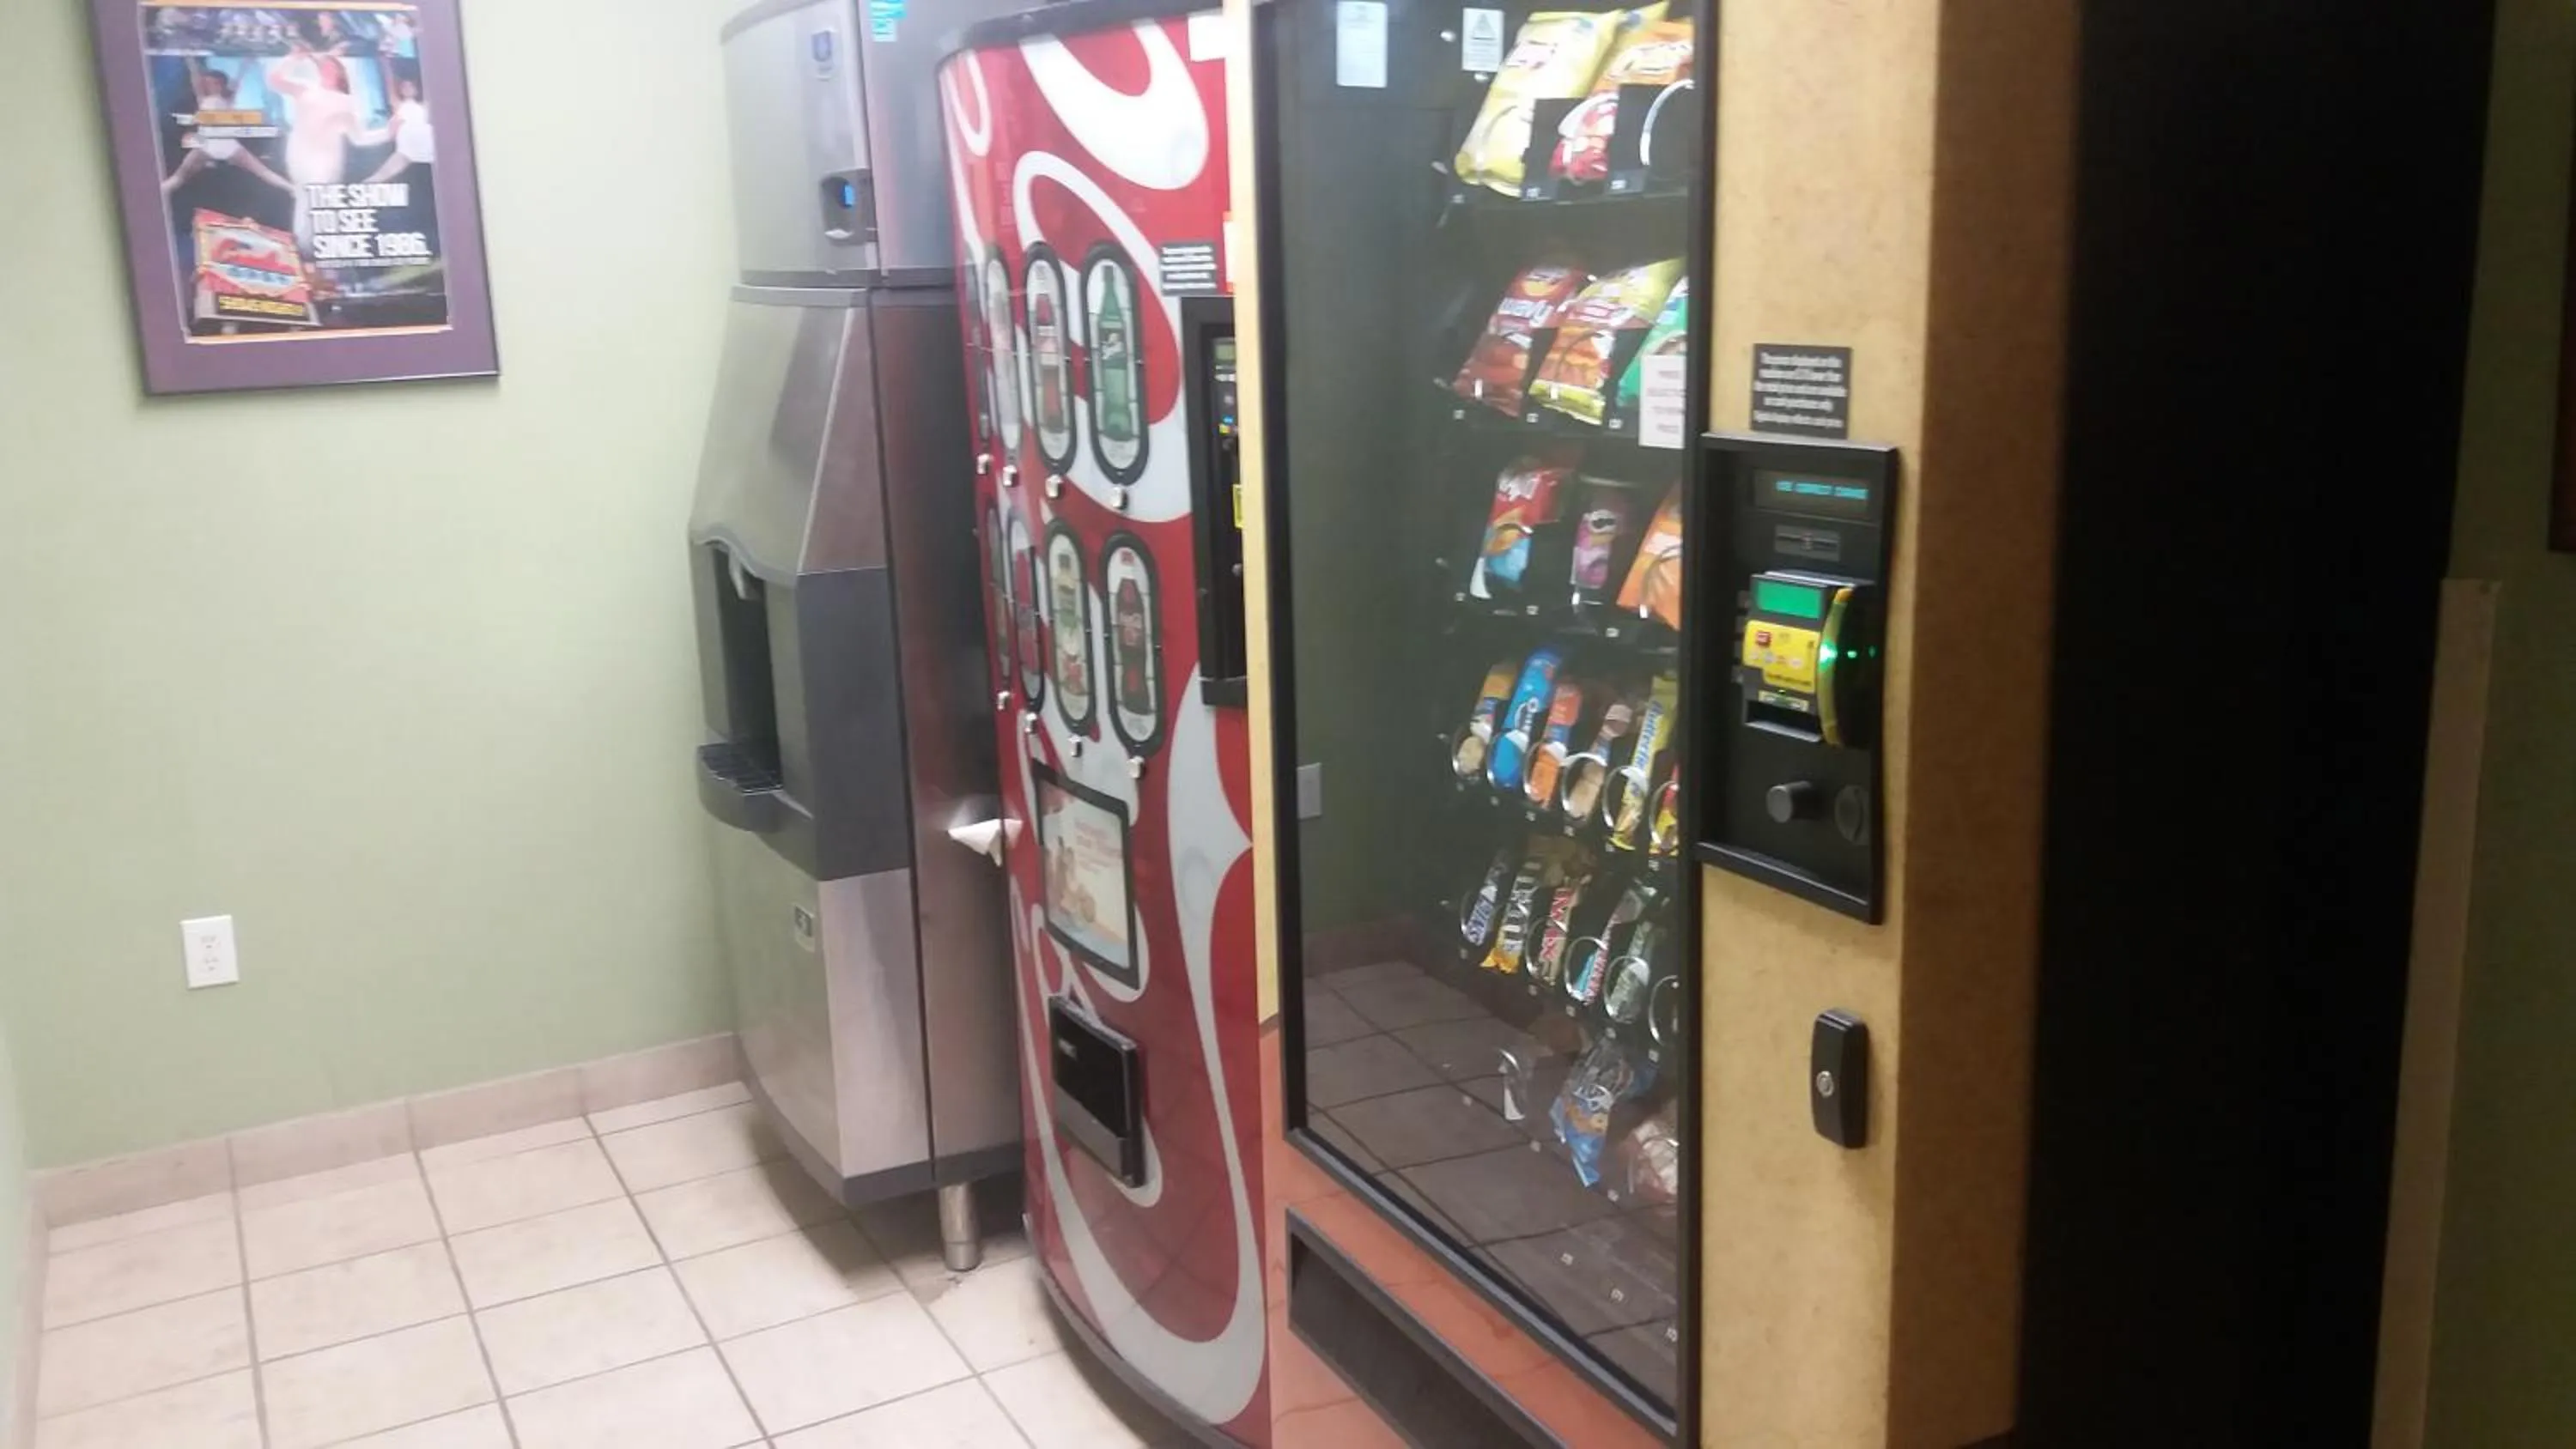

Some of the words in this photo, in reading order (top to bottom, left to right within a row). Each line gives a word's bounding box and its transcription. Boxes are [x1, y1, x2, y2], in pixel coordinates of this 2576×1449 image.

[305, 184, 348, 208] THE
[348, 183, 409, 207] SHOW
[309, 209, 337, 233] TO
[337, 209, 380, 233] SEE
[313, 233, 374, 258] SINCE
